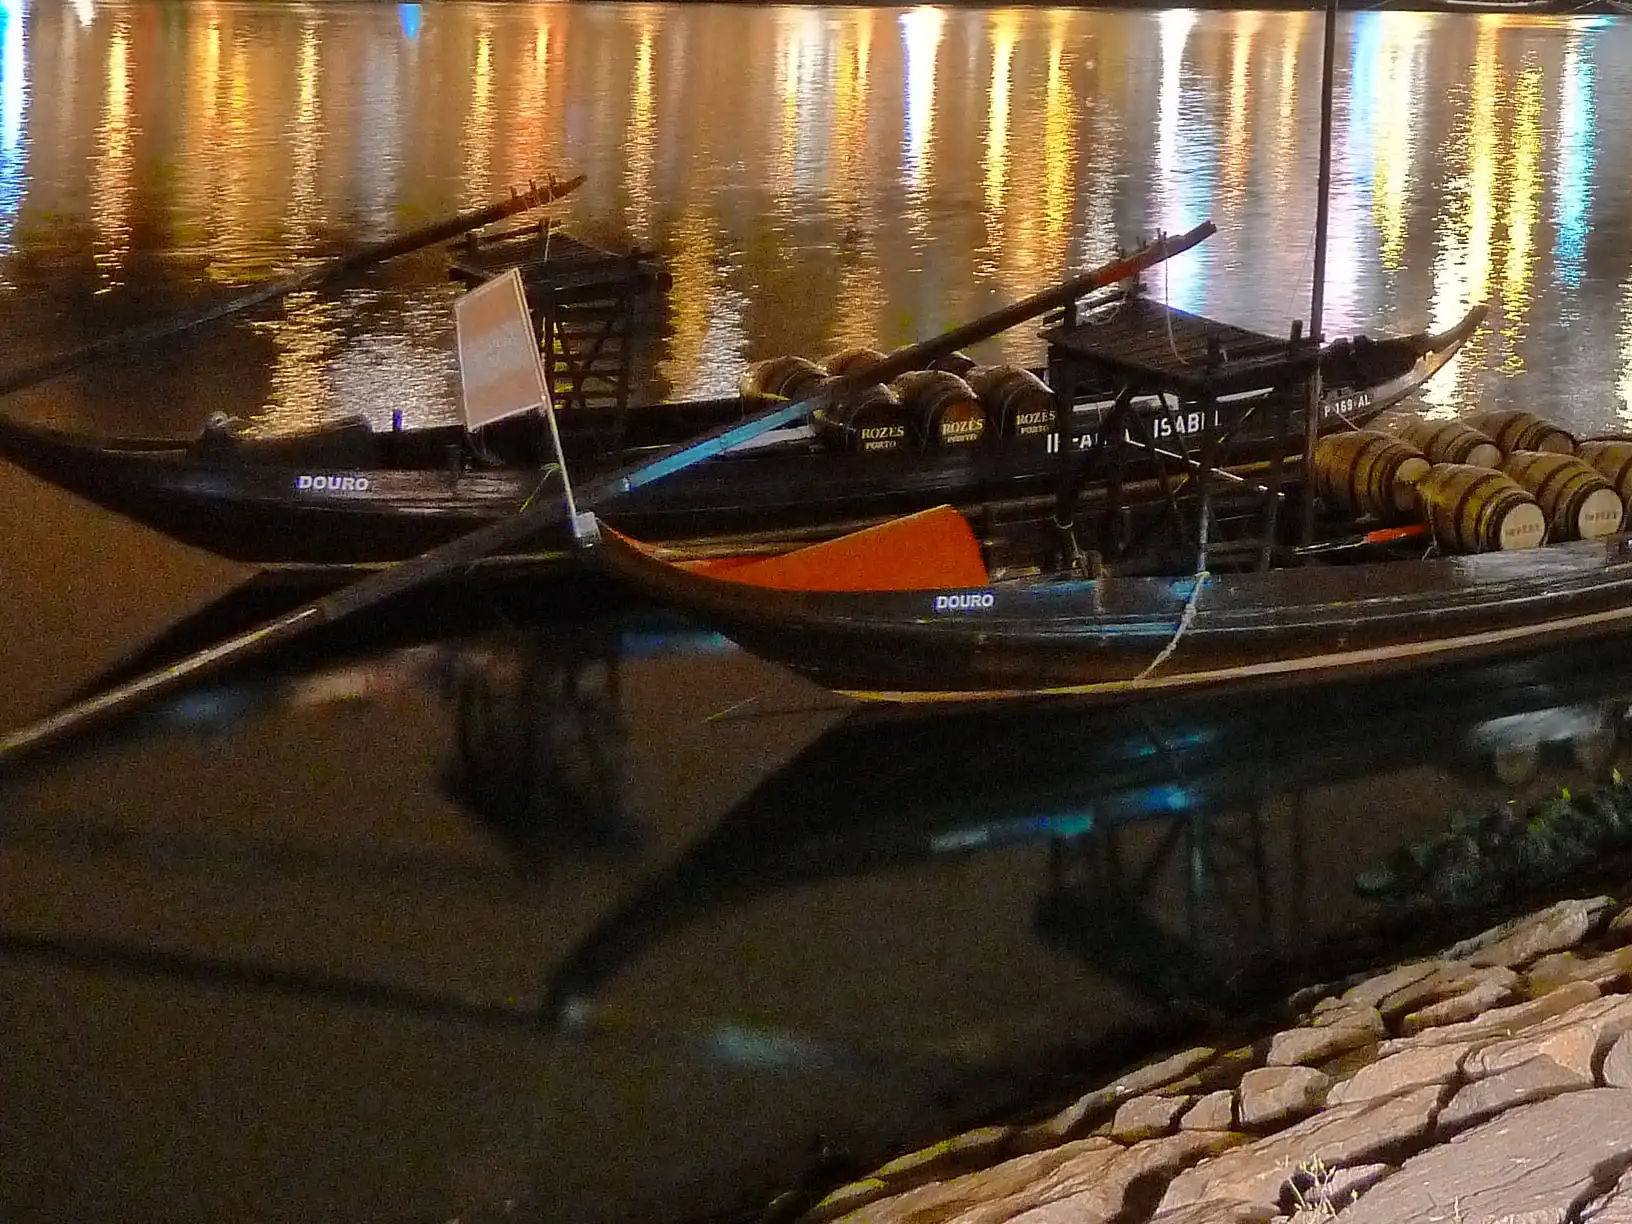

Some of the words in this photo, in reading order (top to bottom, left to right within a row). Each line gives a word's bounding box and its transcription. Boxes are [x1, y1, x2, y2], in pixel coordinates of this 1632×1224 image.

[1153, 409, 1222, 439] ISABL
[297, 475, 369, 491] DOURO
[935, 594, 995, 610] DOURO
